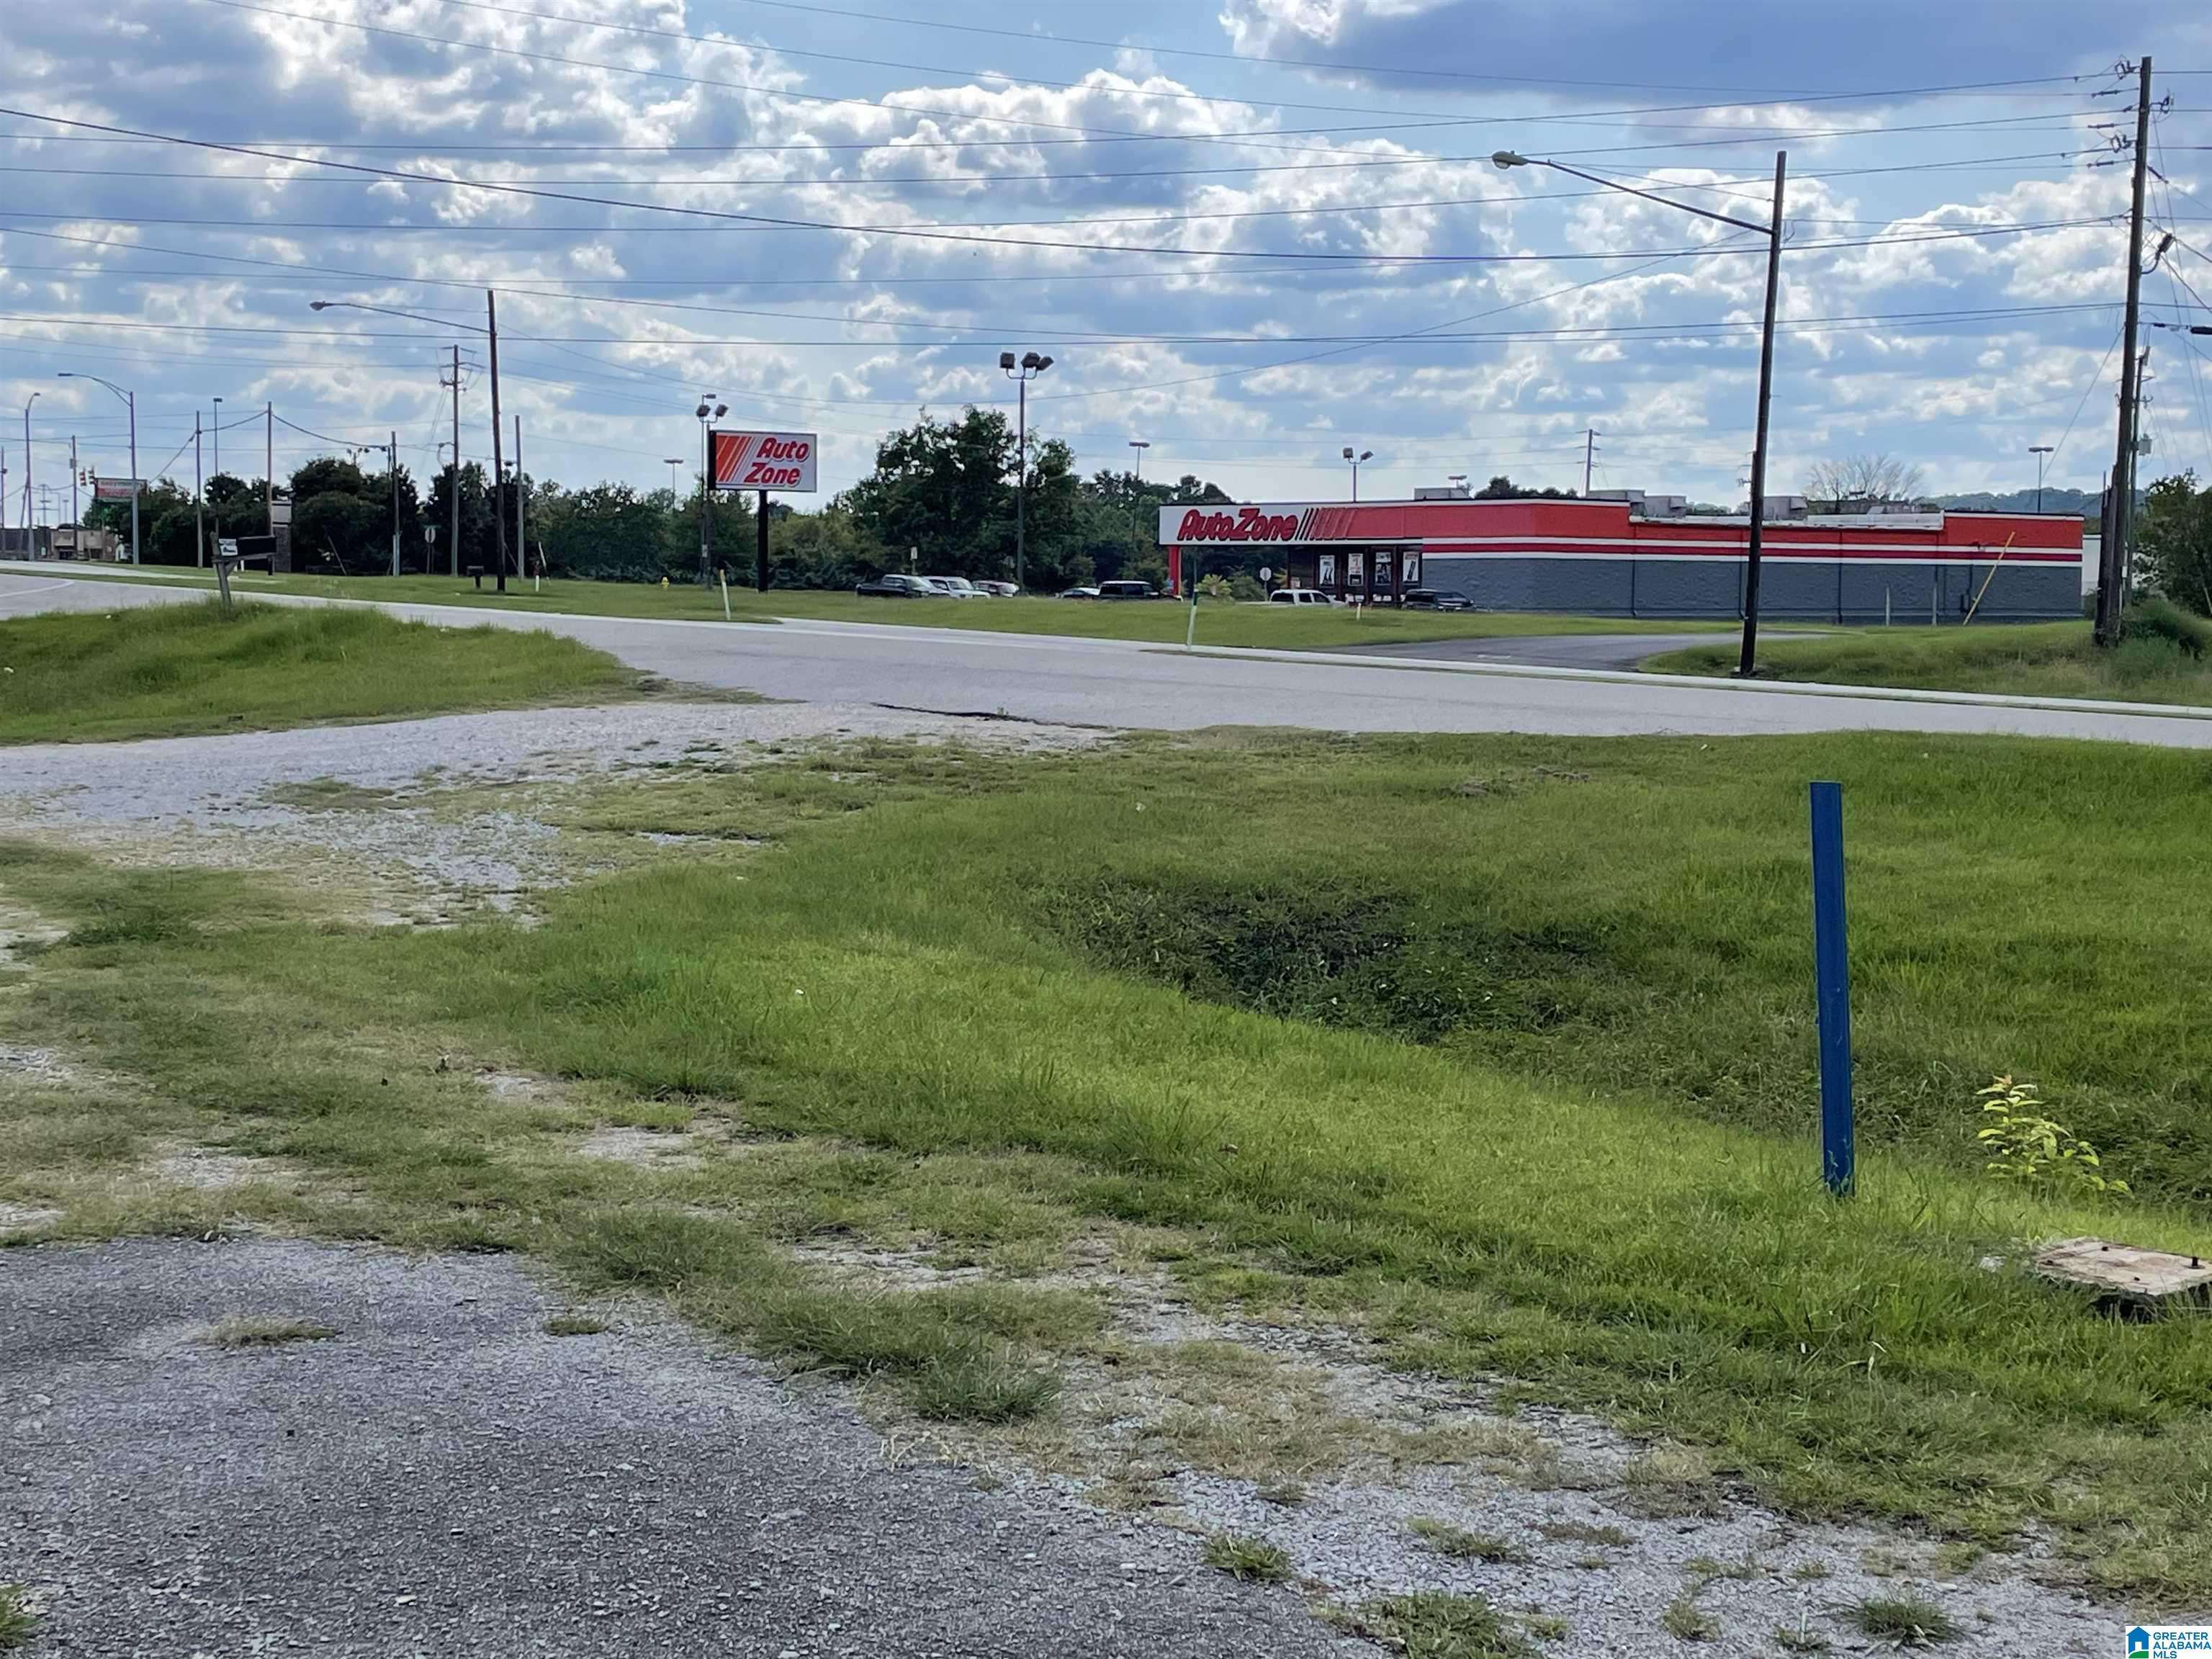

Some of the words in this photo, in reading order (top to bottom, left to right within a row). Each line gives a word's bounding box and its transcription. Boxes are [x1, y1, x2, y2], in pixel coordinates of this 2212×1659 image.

[757, 437, 809, 459] Auto
[744, 462, 801, 485] Zone
[1177, 508, 1299, 541] AutoZone
